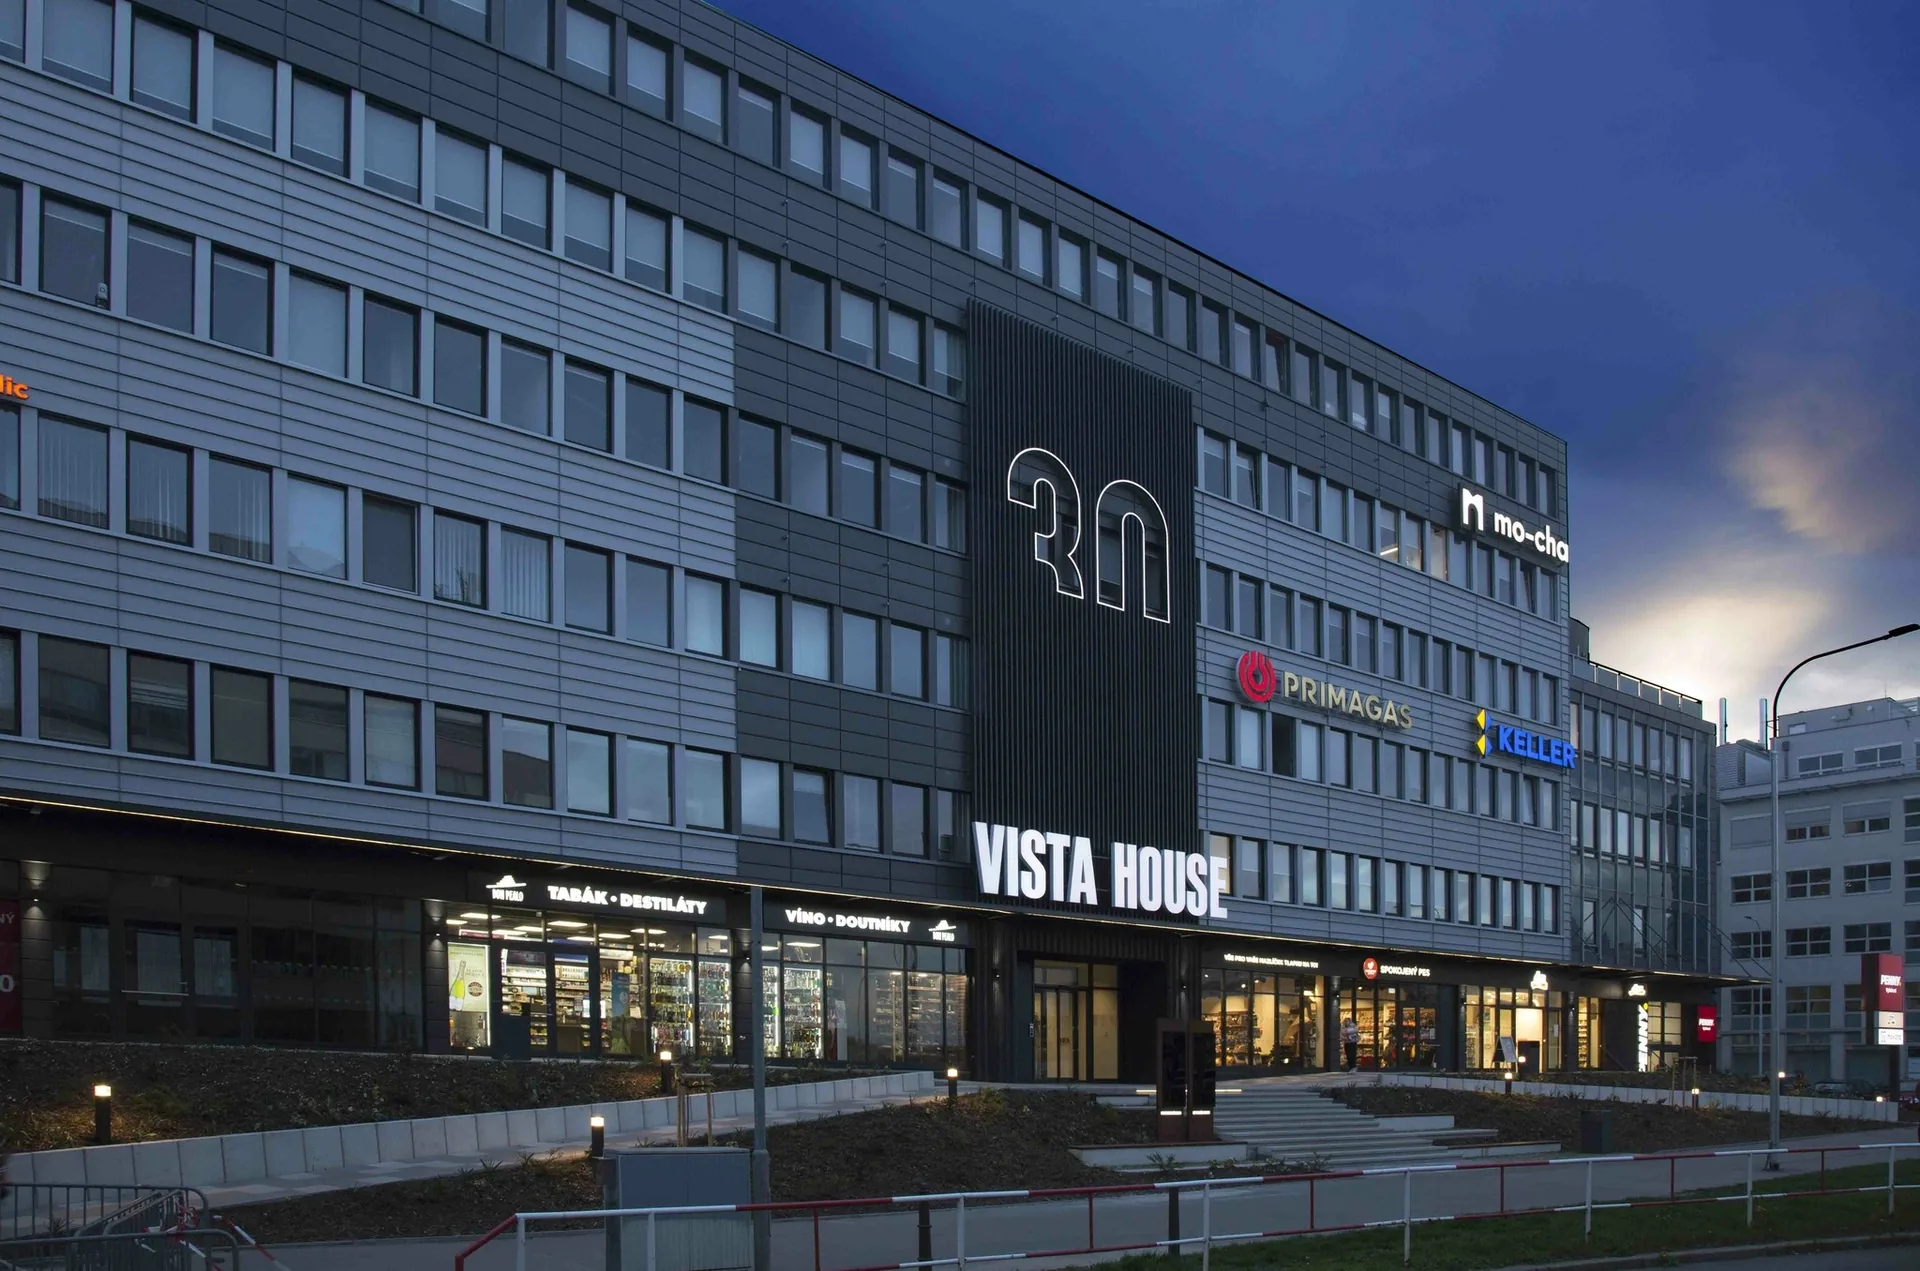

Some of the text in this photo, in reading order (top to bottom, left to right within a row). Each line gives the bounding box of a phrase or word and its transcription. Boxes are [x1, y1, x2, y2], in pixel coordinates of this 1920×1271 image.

[1494, 512, 1569, 563] mo-cha
[1284, 671, 1414, 730] PRIMAGAS
[1497, 724, 1576, 770] KELLER
[971, 821, 1228, 919] VISTA HOUSE
[547, 885, 708, 915] TABÁK DESTILÁTY
[785, 907, 911, 933] VÍNO DOUTNÍKY
[1380, 965, 1417, 975] SPOKOJENÝ
[1418, 968, 1430, 977] PES
